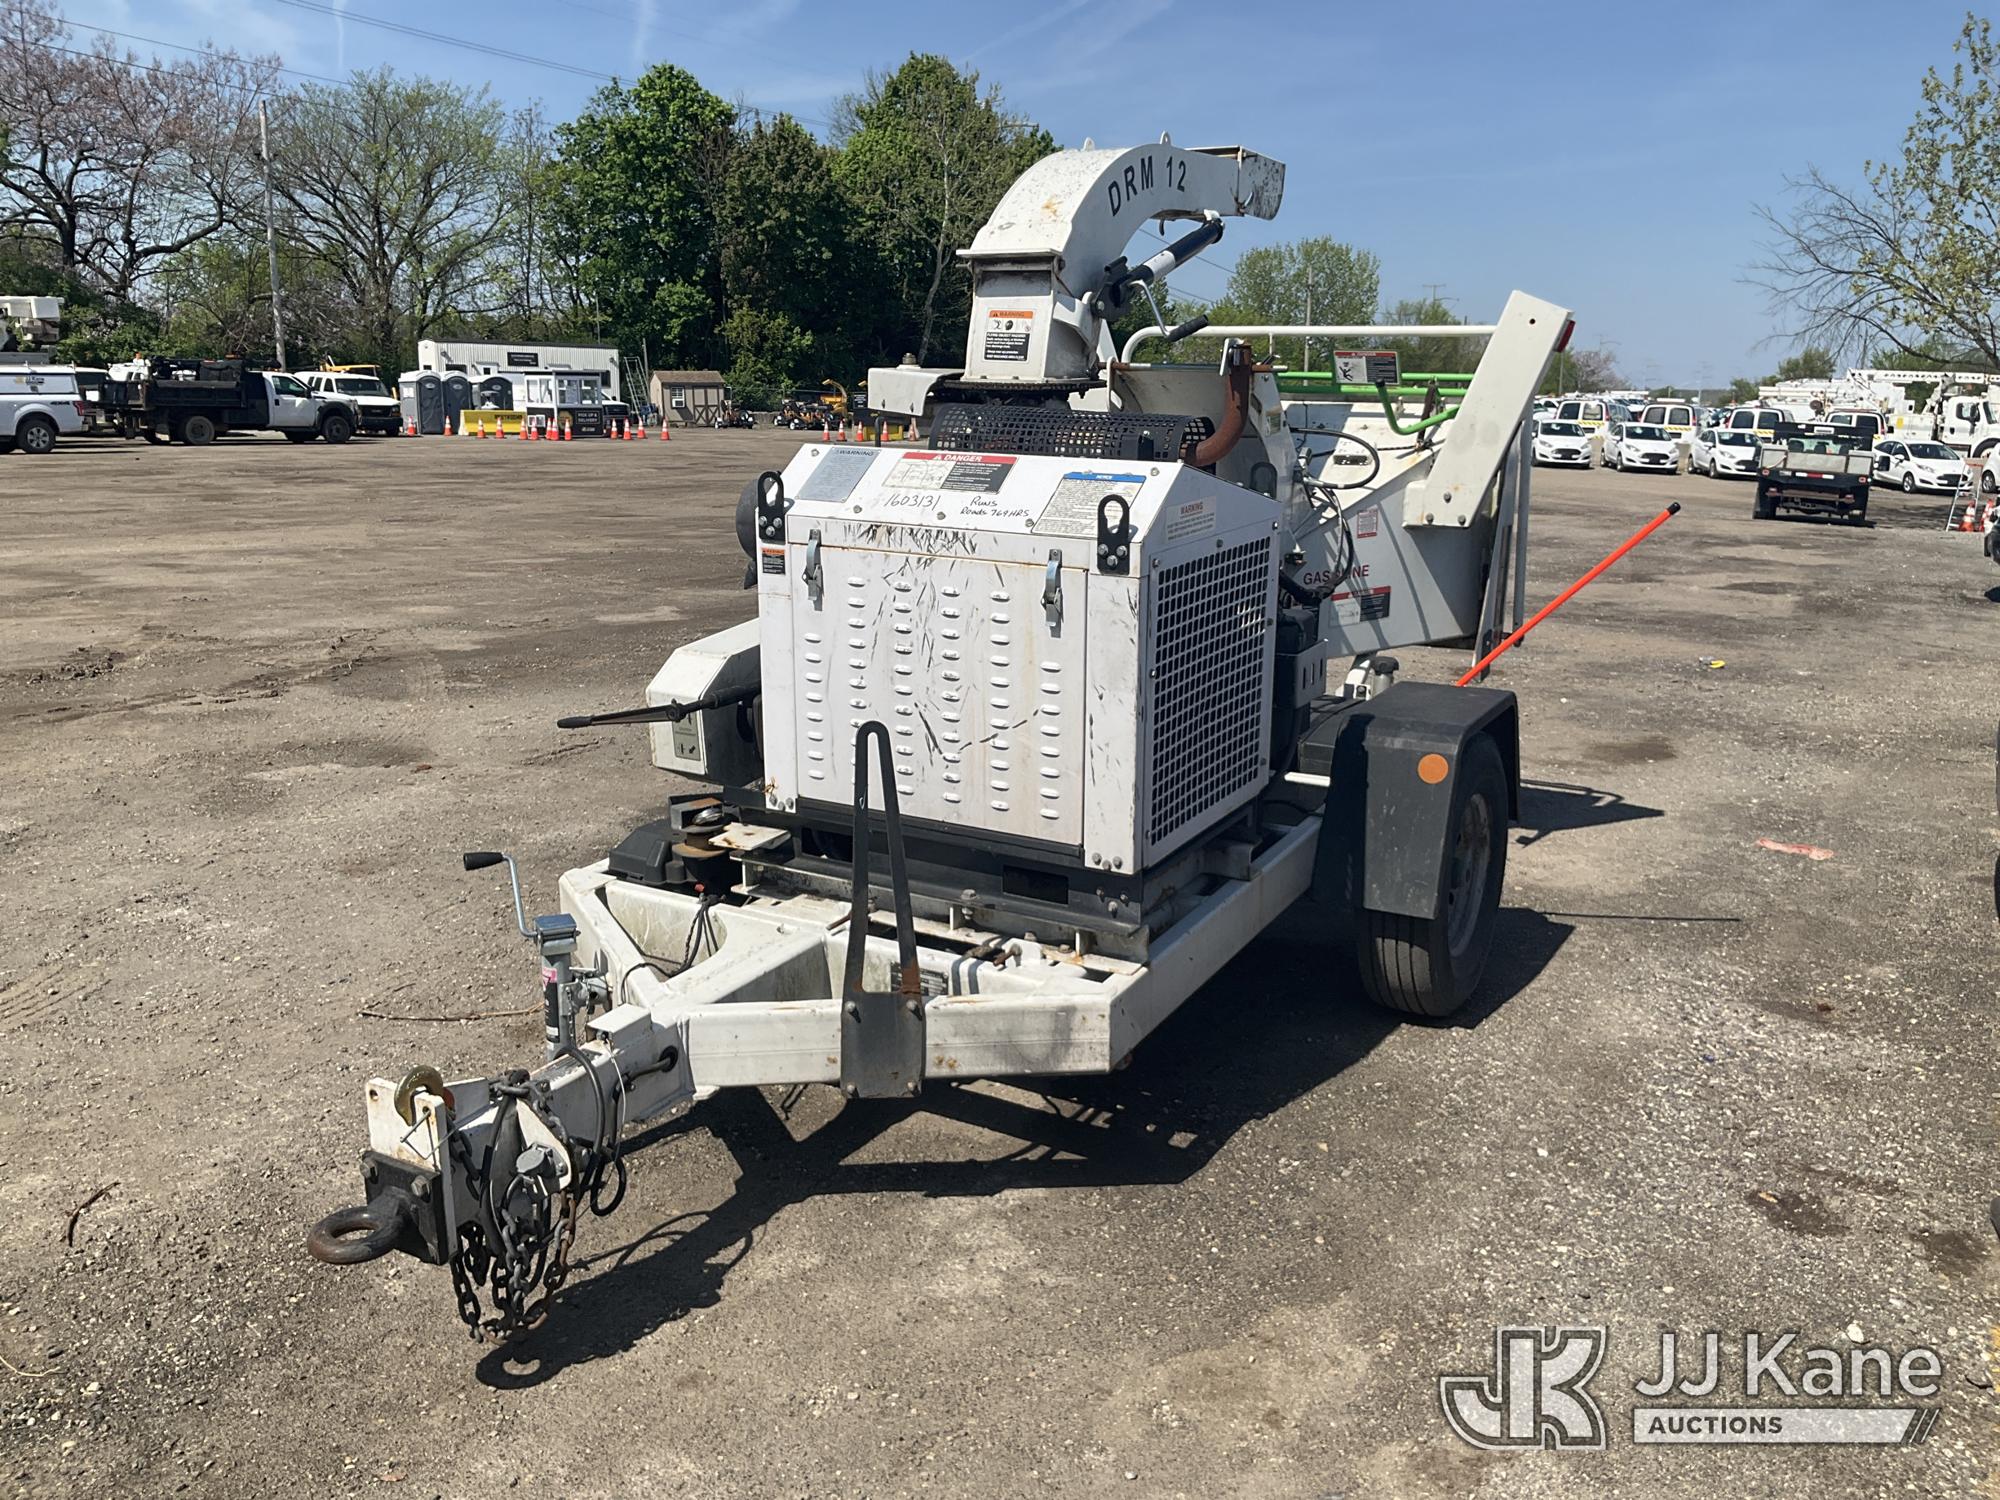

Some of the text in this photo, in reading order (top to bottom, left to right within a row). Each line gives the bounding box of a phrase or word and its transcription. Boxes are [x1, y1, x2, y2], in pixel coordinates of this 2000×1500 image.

[1108, 155, 1186, 217] DRM 12
[944, 454, 983, 462] DANGER
[970, 495, 998, 506] Runs
[1303, 564, 1369, 586] GASNE
